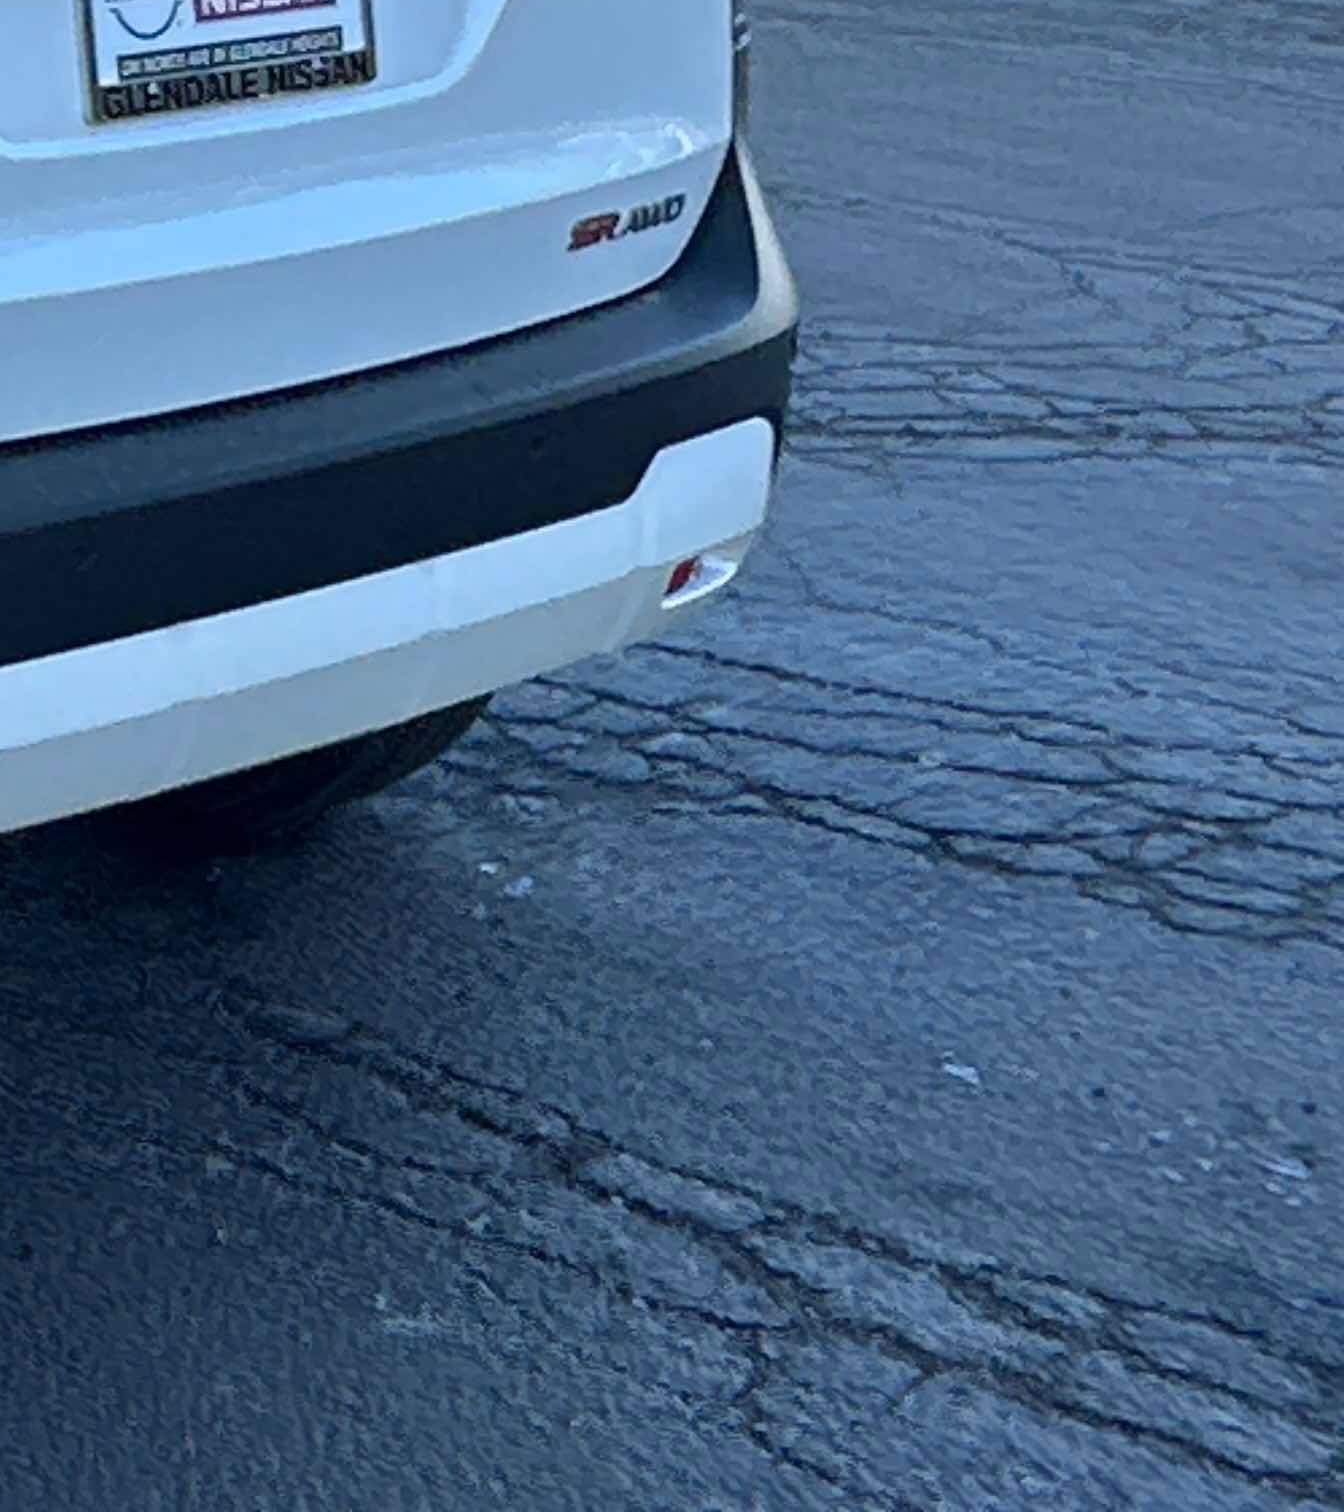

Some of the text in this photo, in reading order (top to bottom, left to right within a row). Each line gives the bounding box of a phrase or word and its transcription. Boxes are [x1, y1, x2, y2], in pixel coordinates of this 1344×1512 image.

[105, 51, 368, 116] GLENDALE NISSAN
[567, 193, 686, 252] SR AWD
